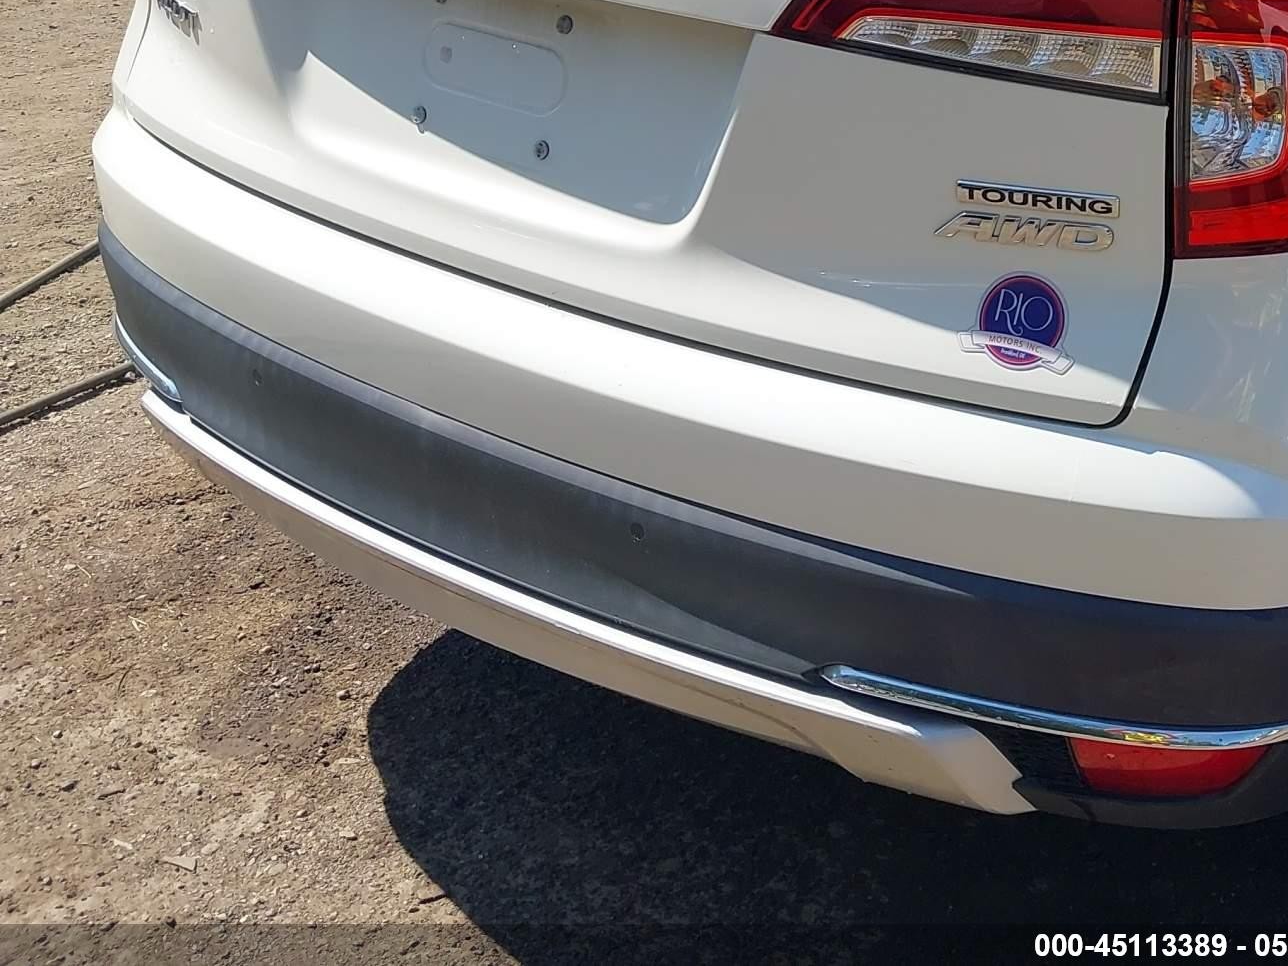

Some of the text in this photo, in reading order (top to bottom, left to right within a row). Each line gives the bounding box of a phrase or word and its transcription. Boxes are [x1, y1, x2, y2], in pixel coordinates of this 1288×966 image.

[962, 185, 1114, 215] TOURING
[934, 209, 1115, 252] AWD
[994, 287, 1054, 337] RIO
[988, 334, 1024, 348] MOTORS
